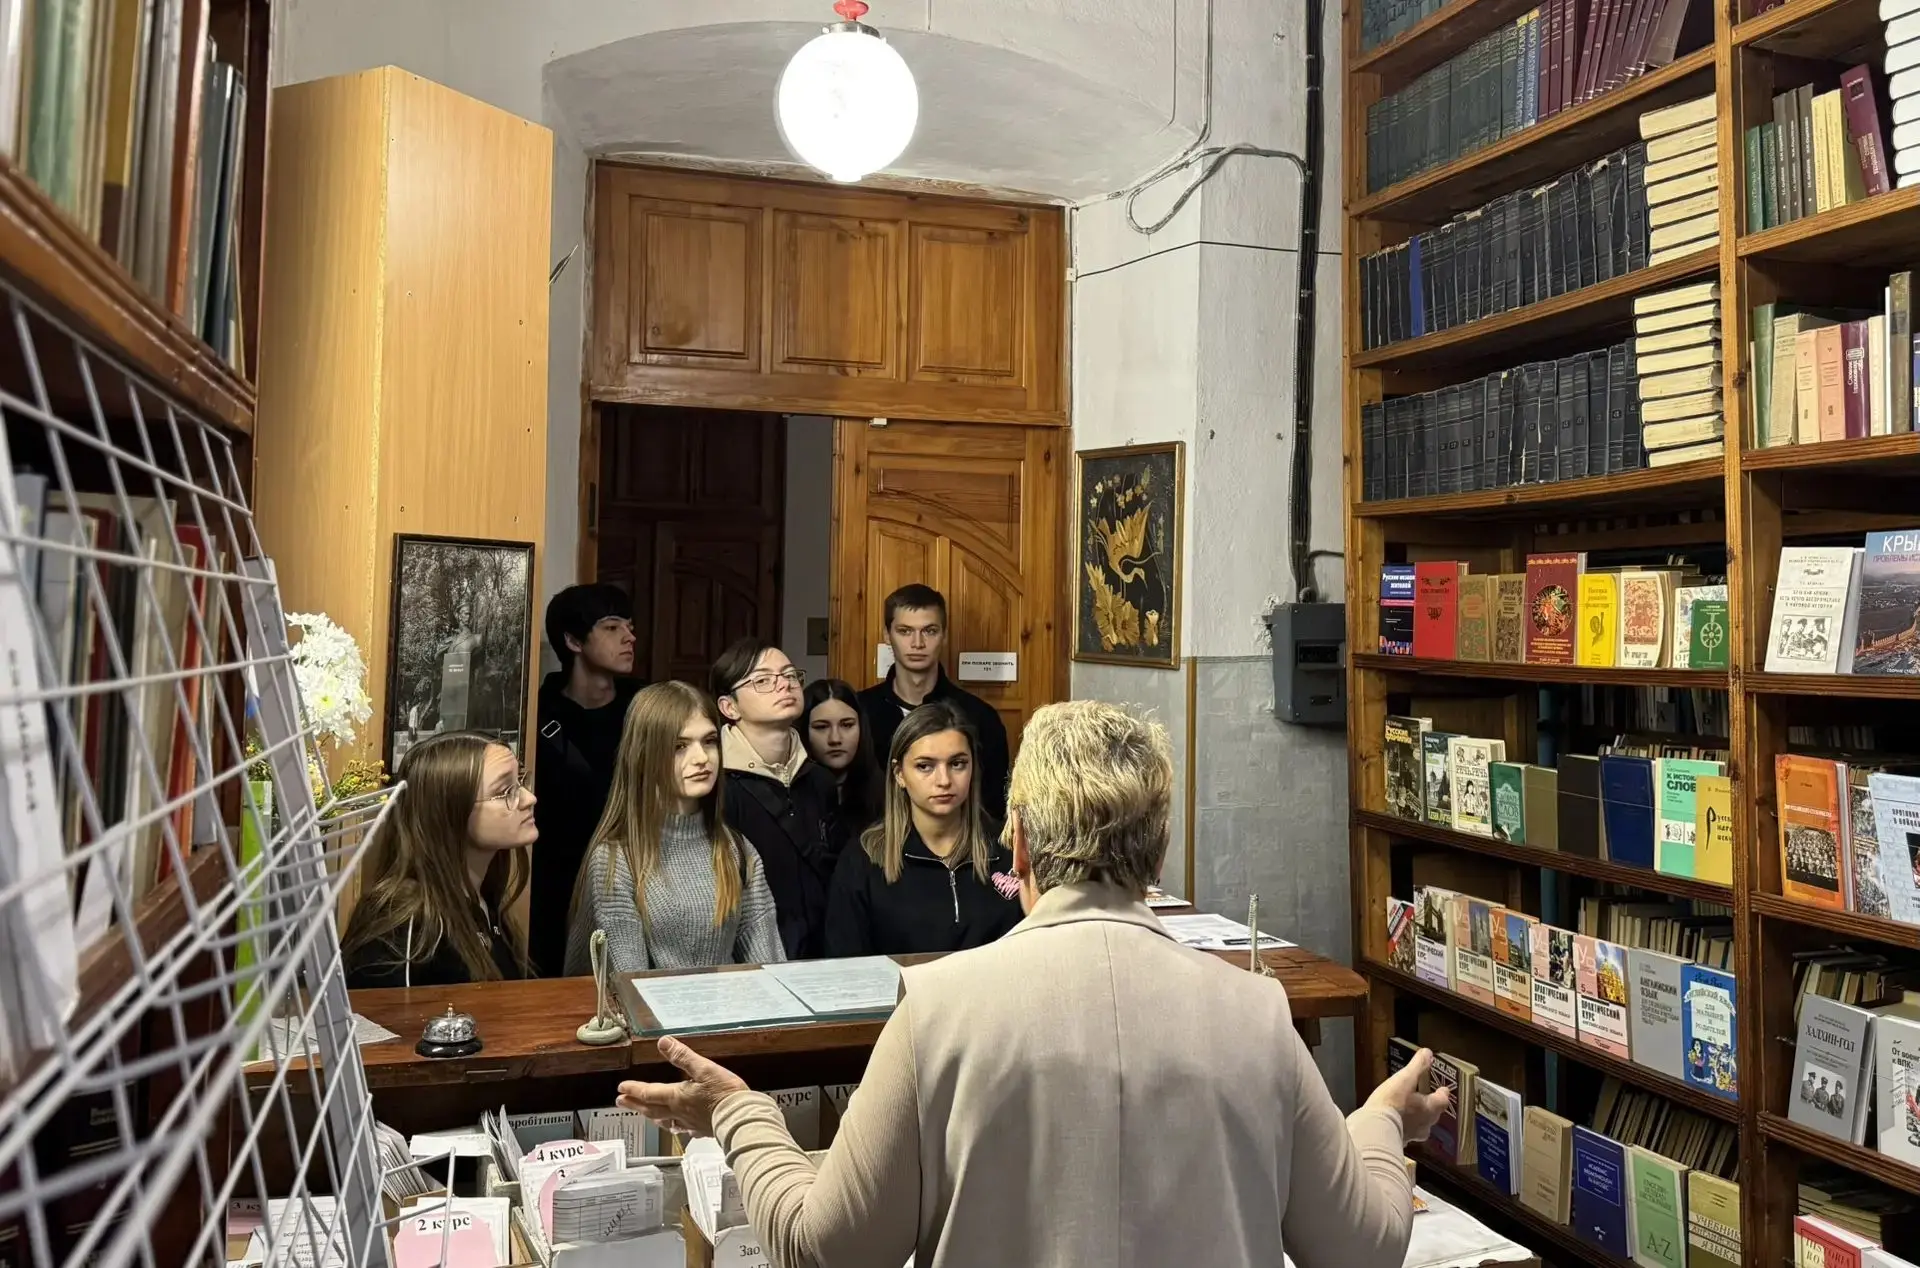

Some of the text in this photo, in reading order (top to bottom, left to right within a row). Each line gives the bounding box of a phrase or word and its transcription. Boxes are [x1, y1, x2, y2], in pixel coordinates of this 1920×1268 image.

[1883, 534, 1920, 552] КРЫ
[1496, 964, 1526, 985] ПРАКТИЧЕСКИЙ
[1496, 976, 1508, 986] КУРС
[1534, 983, 1568, 1003] ПРАКТИЧЕСКИЙ
[1640, 976, 1677, 996] АНГЛИЙСКИЙ
[1640, 987, 1658, 1000] ЯЗЫК
[1534, 993, 1546, 1004] КУРС
[1581, 999, 1621, 1020] ПРАКТИЧЕСКИЙ
[1582, 1009, 1595, 1022] КУРС
[1806, 1024, 1855, 1052] ХАЛХИН-ГОЛ
[1892, 1047, 1900, 1056] От
[776, 1090, 812, 1107] курс
[500, 1114, 572, 1130] вробітники
[536, 1144, 584, 1162] 4 курс
[558, 1170, 566, 1178] 3
[417, 1216, 471, 1233] 2 крс
[1696, 1214, 1740, 1240] УЧЕБНИК
[1701, 1240, 1737, 1262] ЯЗЫКА
